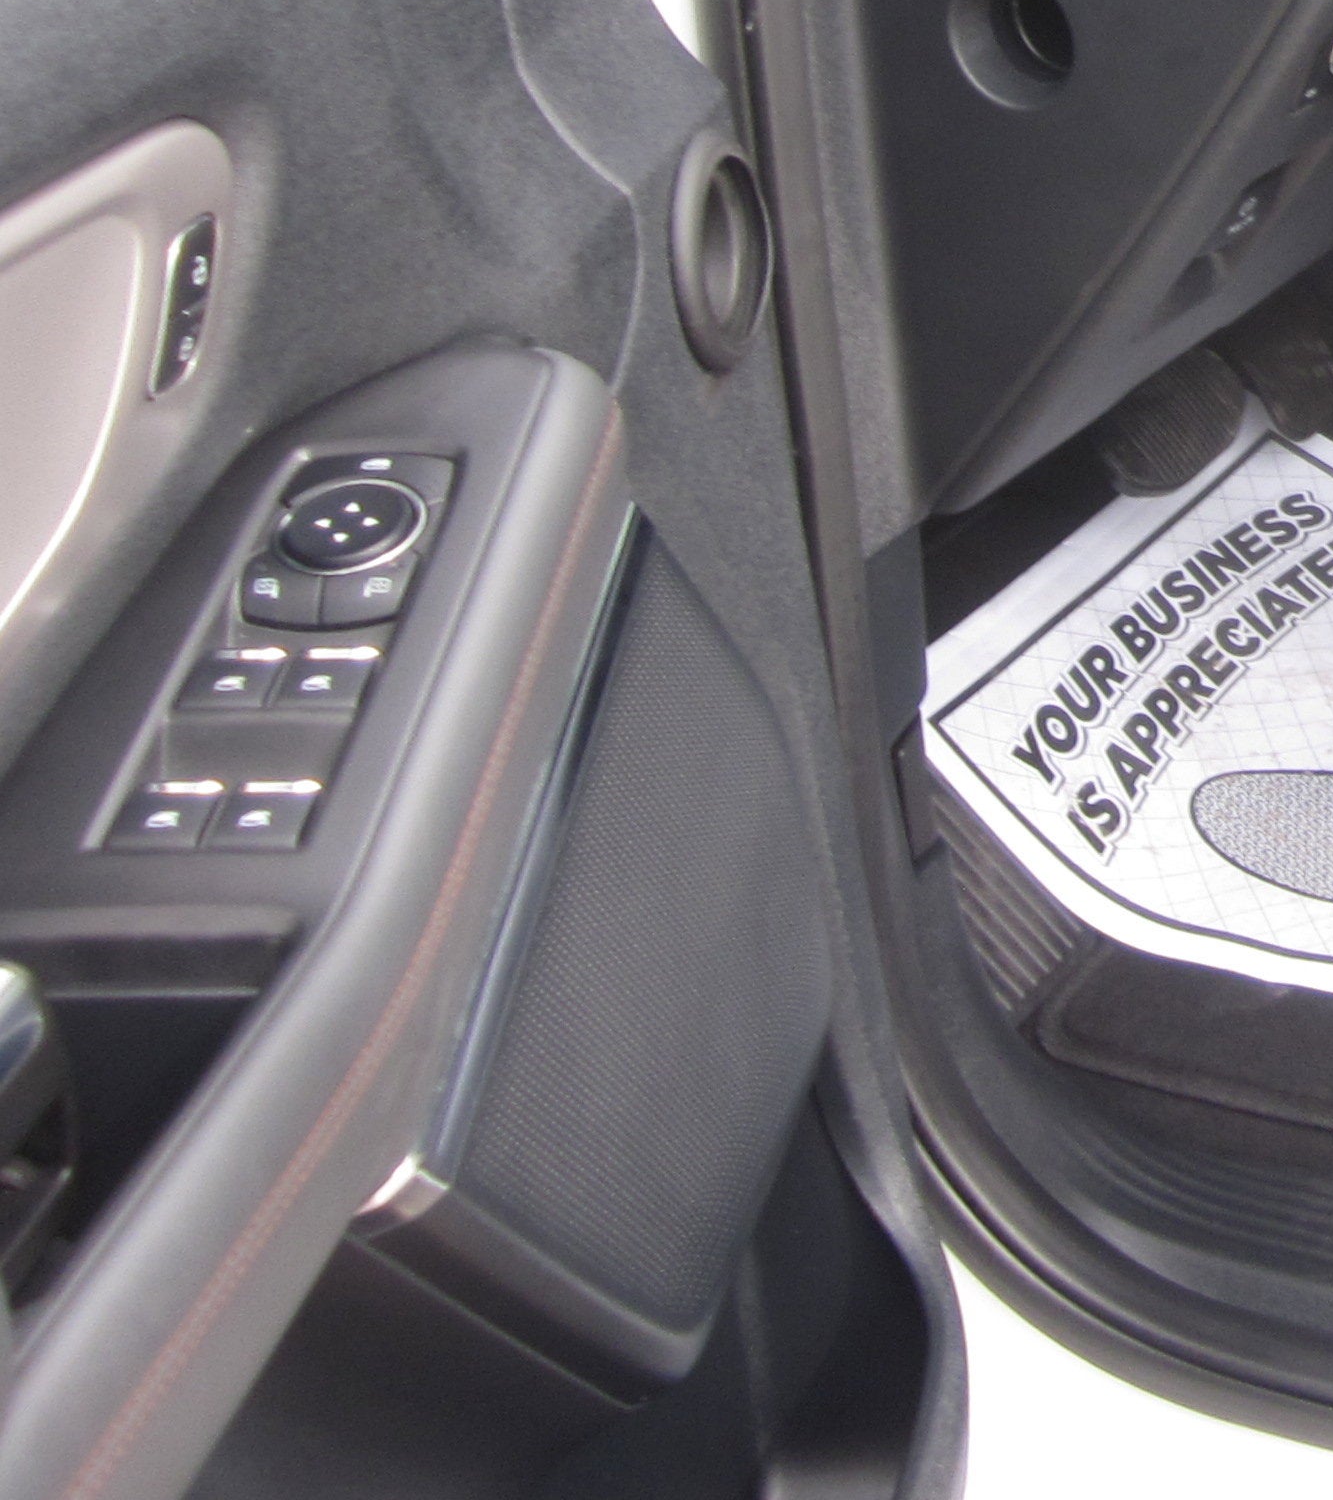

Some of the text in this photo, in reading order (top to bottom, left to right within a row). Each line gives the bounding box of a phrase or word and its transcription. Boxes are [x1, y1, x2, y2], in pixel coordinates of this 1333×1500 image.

[1011, 493, 1328, 785] YOUR BUSINESS
[1066, 780, 1122, 856] IS
